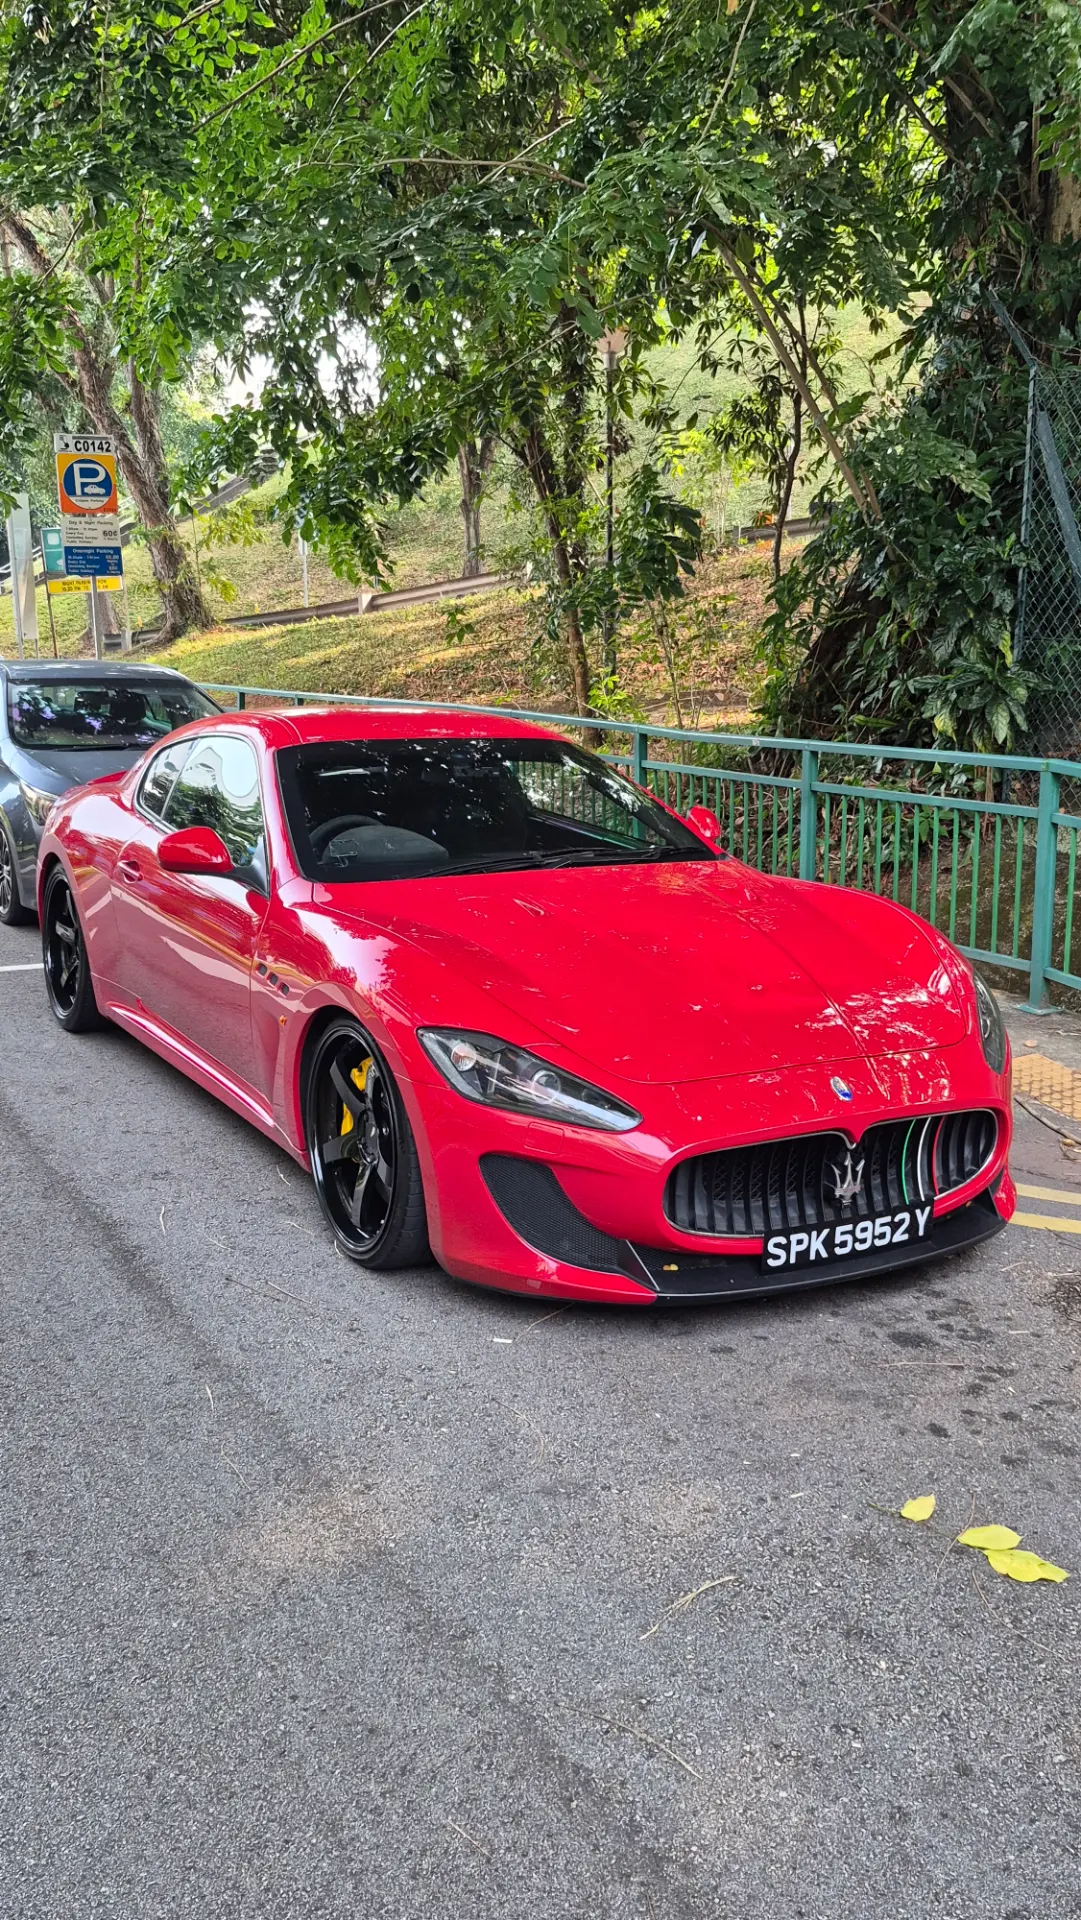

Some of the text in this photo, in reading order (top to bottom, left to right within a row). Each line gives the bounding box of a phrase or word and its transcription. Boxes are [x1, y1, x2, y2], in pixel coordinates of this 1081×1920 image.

[74, 440, 111, 452] C0142
[73, 463, 106, 496] P
[766, 1206, 931, 1268] SPK 5952 Y
